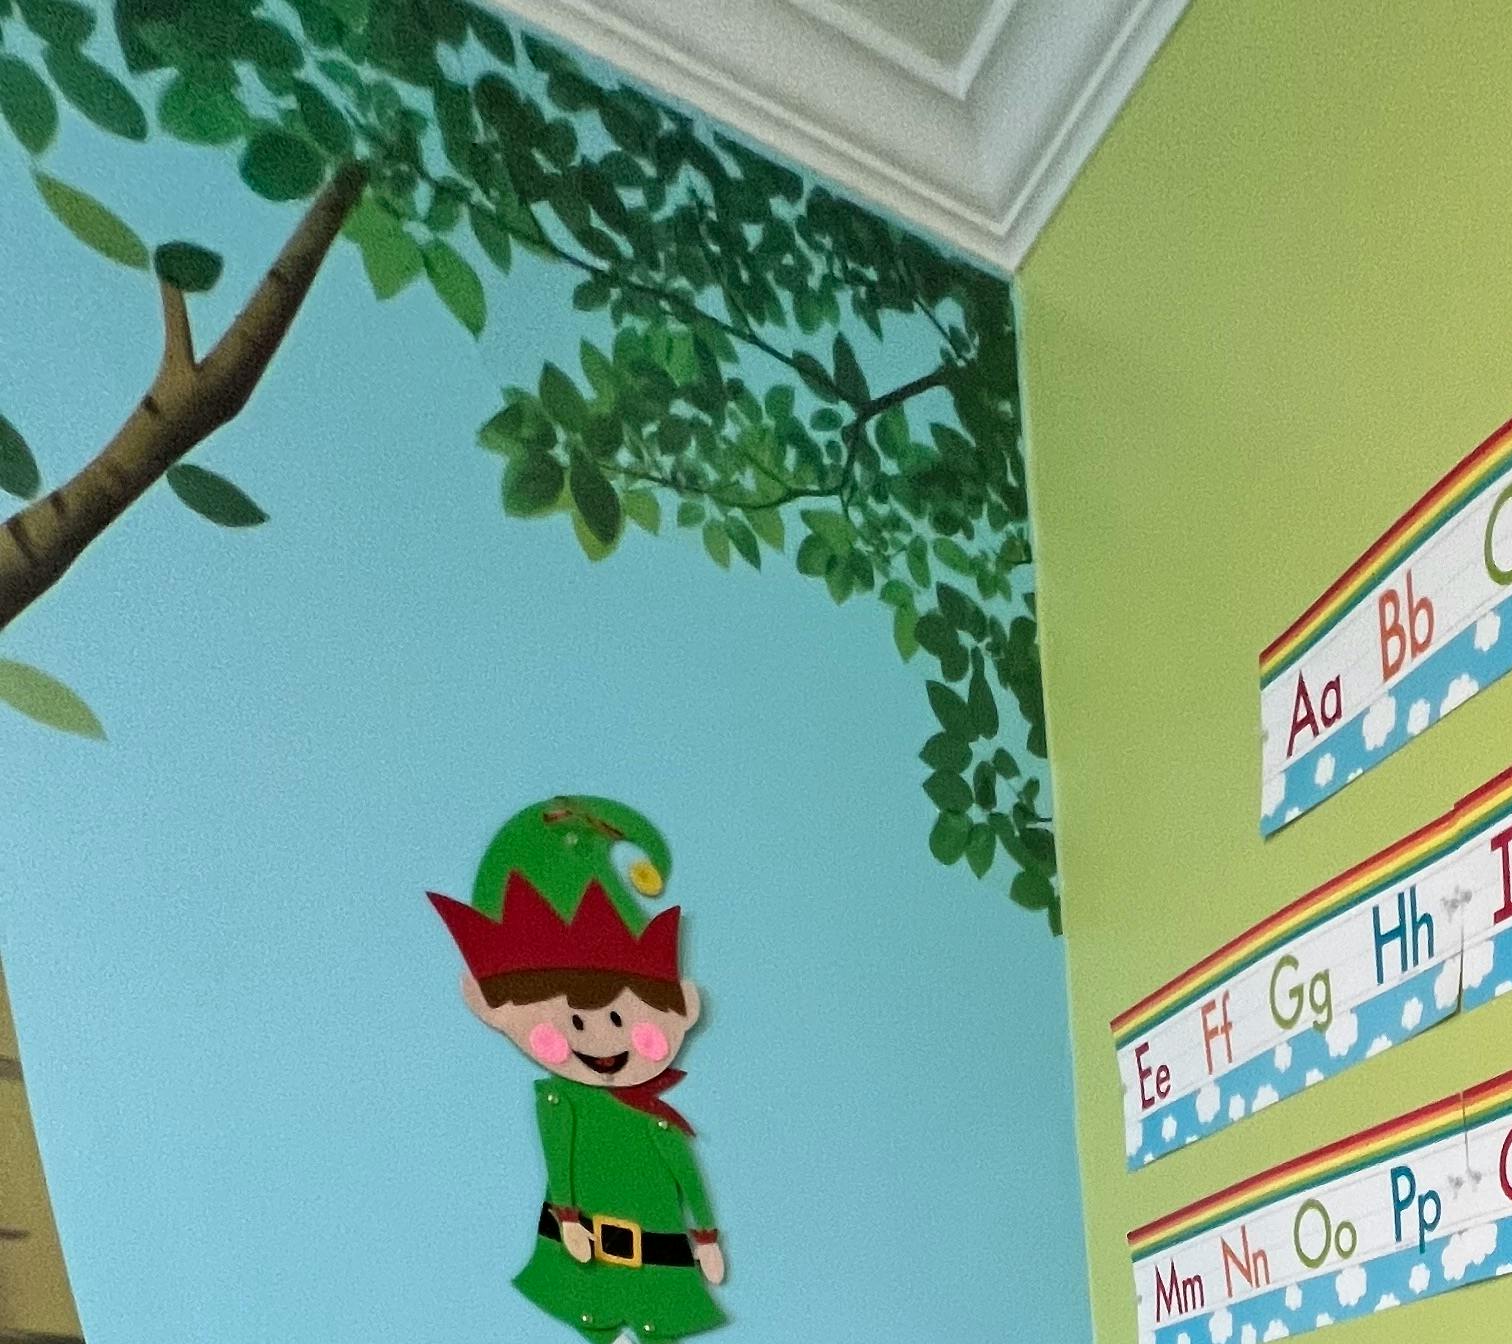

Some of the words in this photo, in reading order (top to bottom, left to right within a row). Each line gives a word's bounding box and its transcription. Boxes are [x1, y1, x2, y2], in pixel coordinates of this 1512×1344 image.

[1287, 670, 1343, 758] Aa
[1379, 571, 1433, 681] Bb
[1135, 1042, 1171, 1110] Ee
[1201, 997, 1234, 1075] Ff
[1270, 955, 1333, 1032] Gg
[1373, 888, 1434, 983] Hh
[1155, 1265, 1204, 1322] Mm
[1222, 1227, 1269, 1298] Nn
[1294, 1199, 1356, 1267] Oo
[1390, 1165, 1441, 1252] Pp
